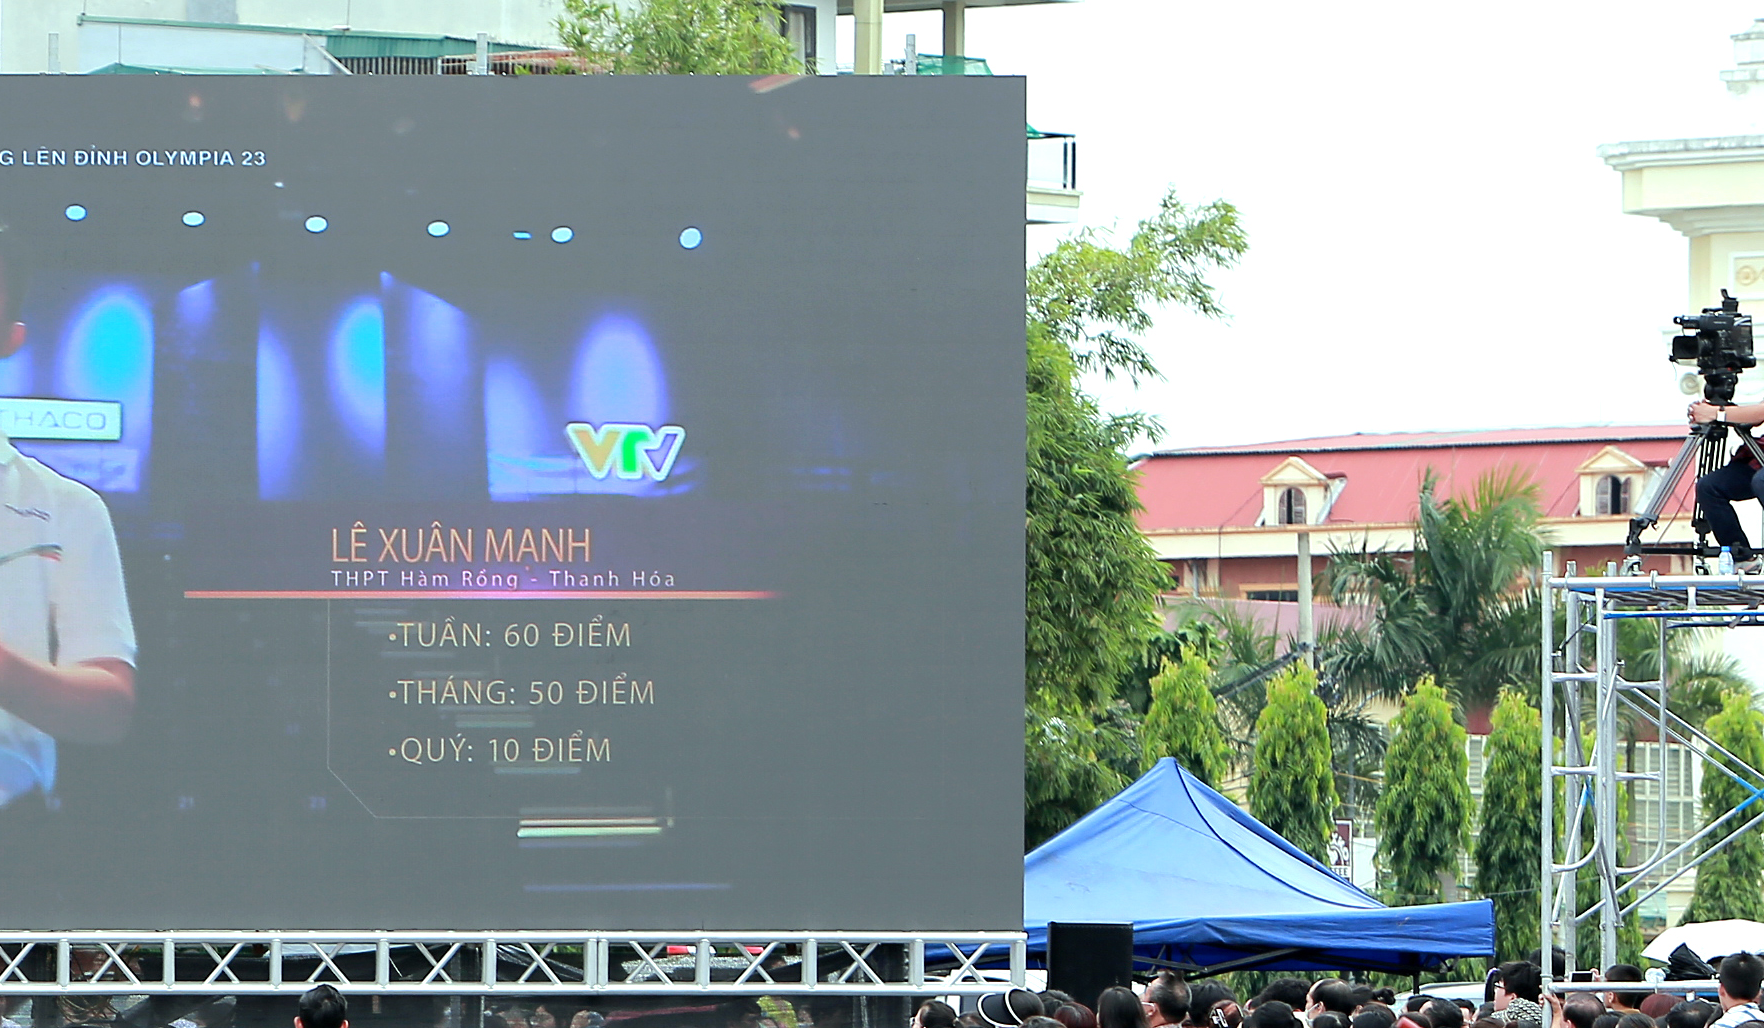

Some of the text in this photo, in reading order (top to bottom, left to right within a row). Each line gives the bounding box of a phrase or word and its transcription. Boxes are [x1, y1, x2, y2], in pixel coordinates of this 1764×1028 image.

[22, 145, 66, 166] LÊN
[74, 144, 128, 166] ĐỈNH
[135, 149, 235, 166] OLYMPIA
[241, 150, 266, 166] 23
[566, 422, 686, 481] VTV
[331, 520, 367, 563] LÊ
[378, 520, 473, 563] XUÂN
[330, 570, 389, 587] THPT
[401, 570, 449, 587] Hàm
[462, 568, 519, 591] Rồng
[549, 570, 619, 587] Thanh
[632, 570, 676, 587] Hóa
[504, 622, 540, 648] 60
[552, 614, 631, 648] ĐIỂM
[529, 680, 564, 705] 50
[575, 672, 655, 705] ĐIỂM
[489, 738, 520, 763] 10
[532, 730, 611, 763] ĐIỂM
